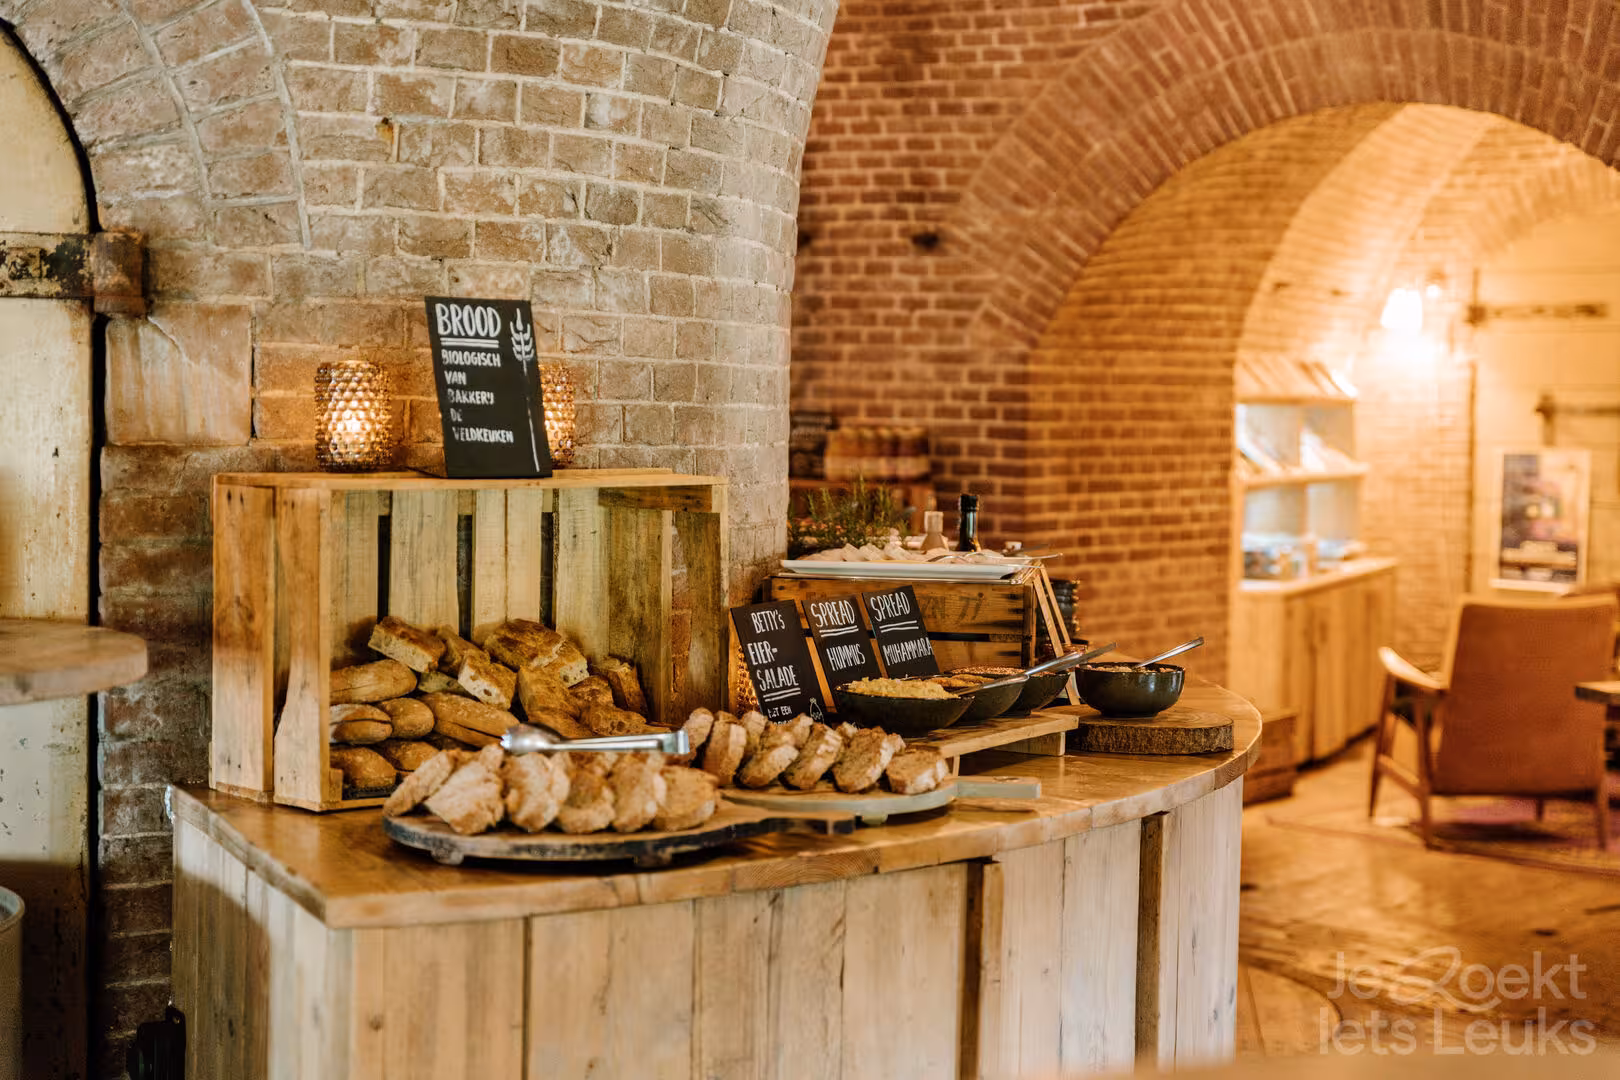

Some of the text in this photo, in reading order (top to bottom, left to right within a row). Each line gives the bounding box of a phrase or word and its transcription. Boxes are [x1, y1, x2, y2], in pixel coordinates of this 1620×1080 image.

[435, 303, 501, 338] BROOD
[441, 348, 501, 367] BIOLOGISCH
[444, 370, 467, 385] VAN
[452, 426, 514, 443] VELDKEUKEN
[810, 599, 855, 628] SPREAD
[870, 591, 911, 622] SPREAD
[747, 640, 778, 666] EIER-
[826, 643, 866, 671] HUMMUS
[882, 636, 935, 666] MUHAMMARA
[756, 664, 799, 692] SALADE
